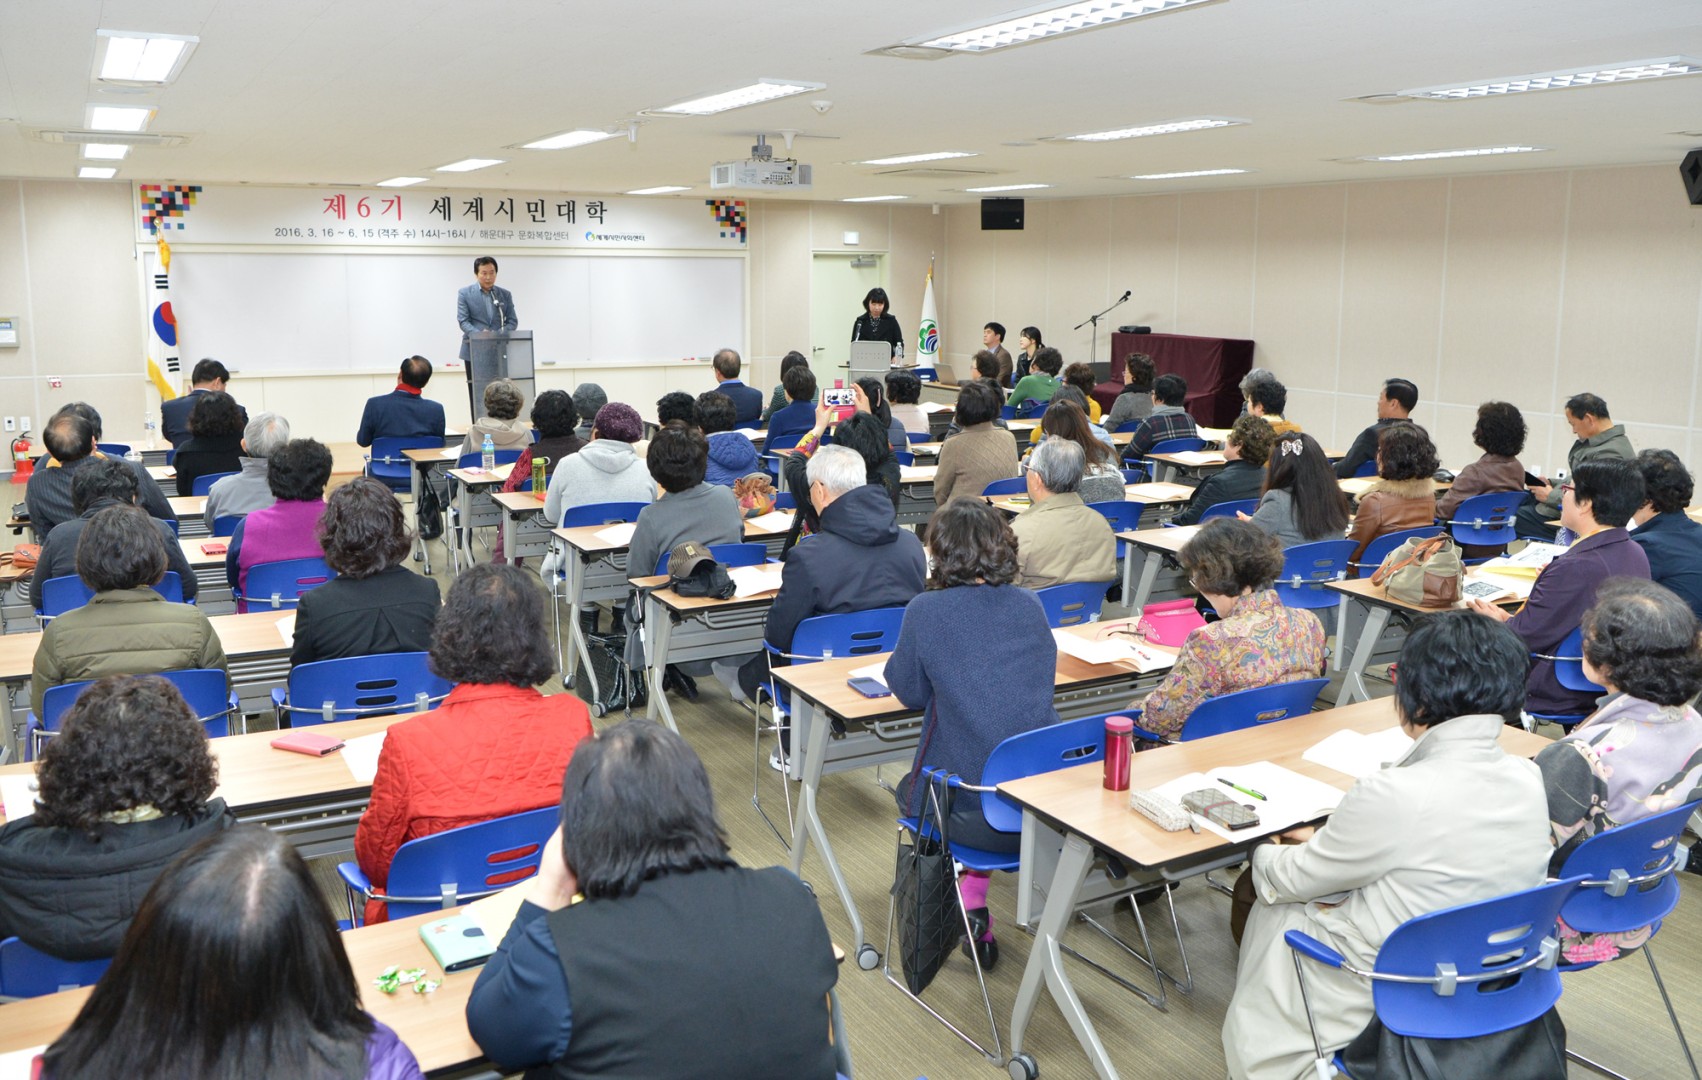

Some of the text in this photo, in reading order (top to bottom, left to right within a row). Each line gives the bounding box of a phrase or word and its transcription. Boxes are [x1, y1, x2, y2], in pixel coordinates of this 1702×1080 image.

[323, 193, 608, 225] 제6기 세계시민대학
[274, 227, 304, 238] 2016.
[307, 228, 317, 238] 3.
[322, 228, 334, 238] 16
[362, 229, 374, 238] 15
[403, 229, 417, 239] 수)
[420, 229, 467, 239] 14시-16시
[479, 229, 515, 240] 해운대구
[518, 230, 569, 241] 문화복합센터
